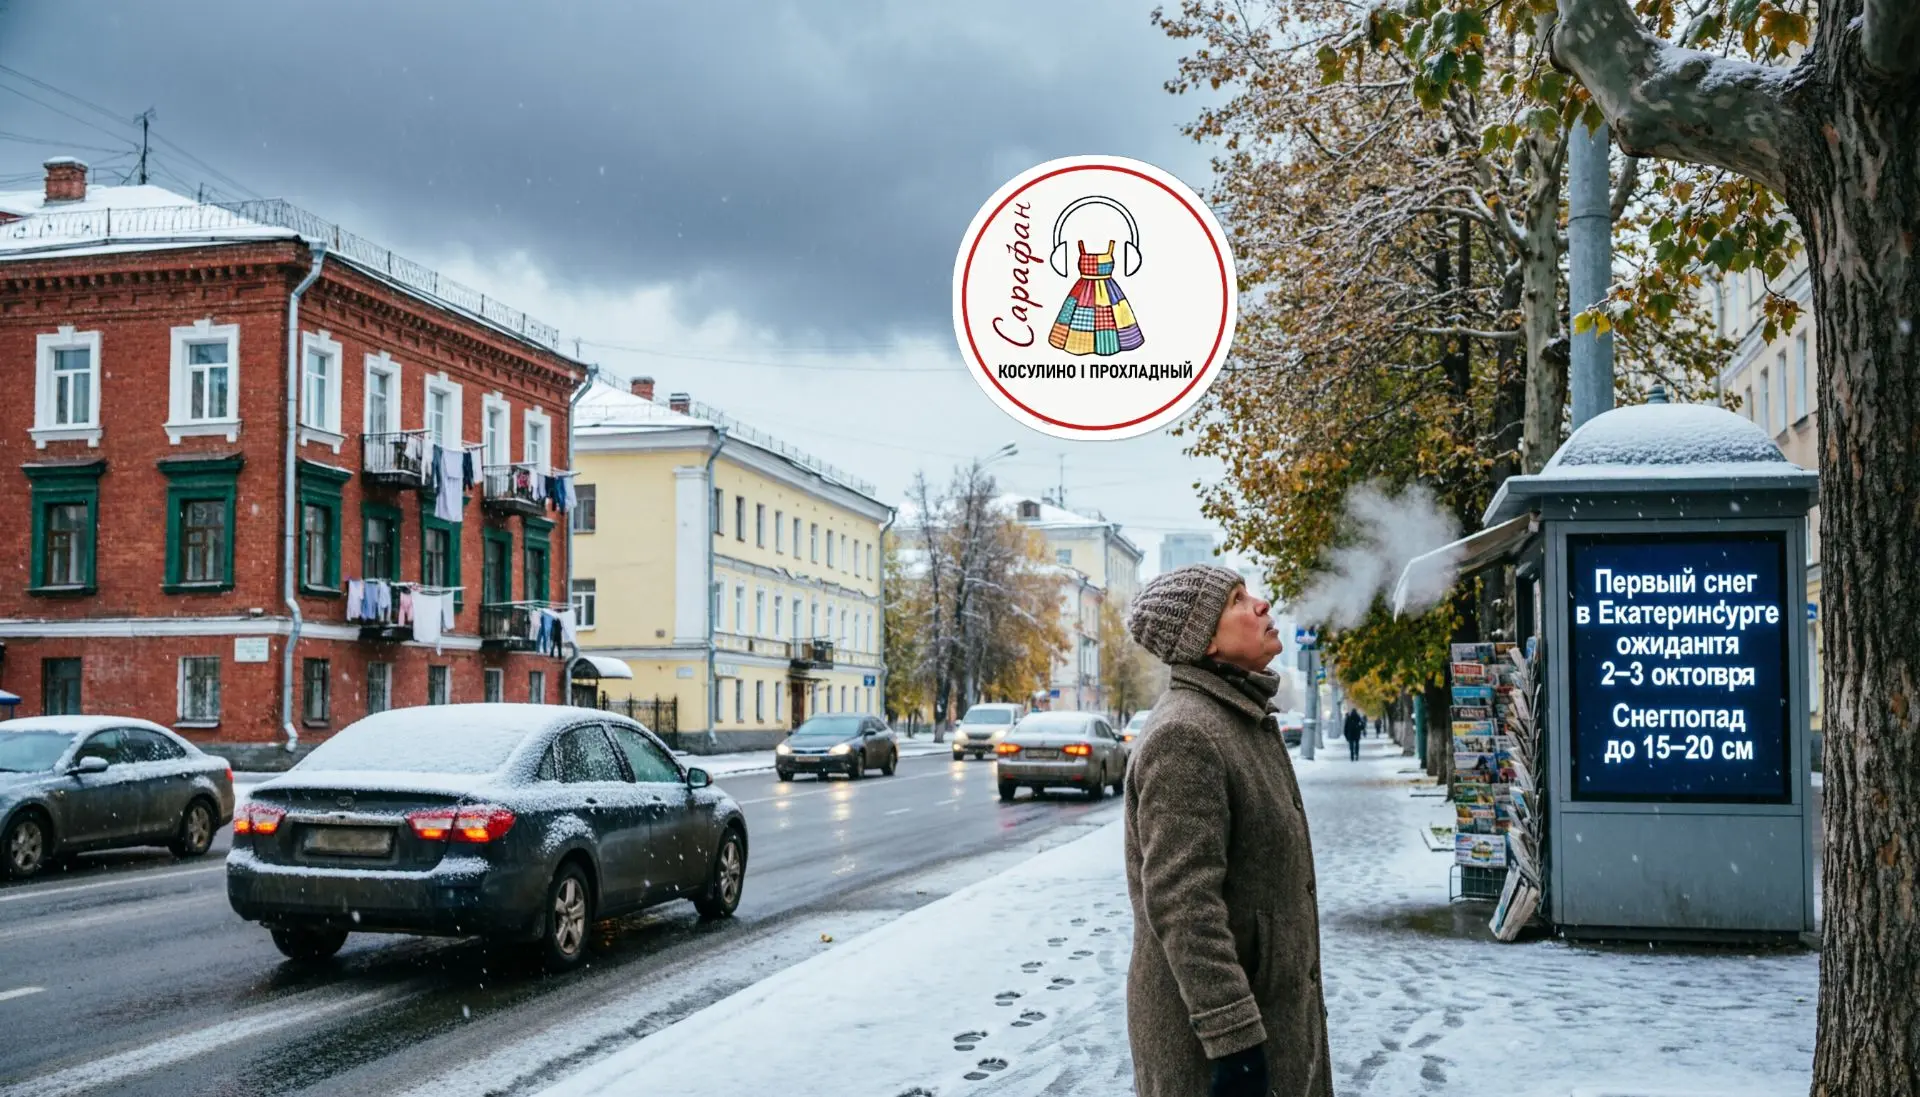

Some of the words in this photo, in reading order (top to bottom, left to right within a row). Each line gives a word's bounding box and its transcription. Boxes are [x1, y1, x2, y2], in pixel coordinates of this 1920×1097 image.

[1703, 574, 1758, 593] снег
[1576, 605, 1591, 625] в
[1612, 702, 1747, 733] Снегпопад
[1603, 740, 1636, 764] до
[1721, 740, 1754, 760] см
